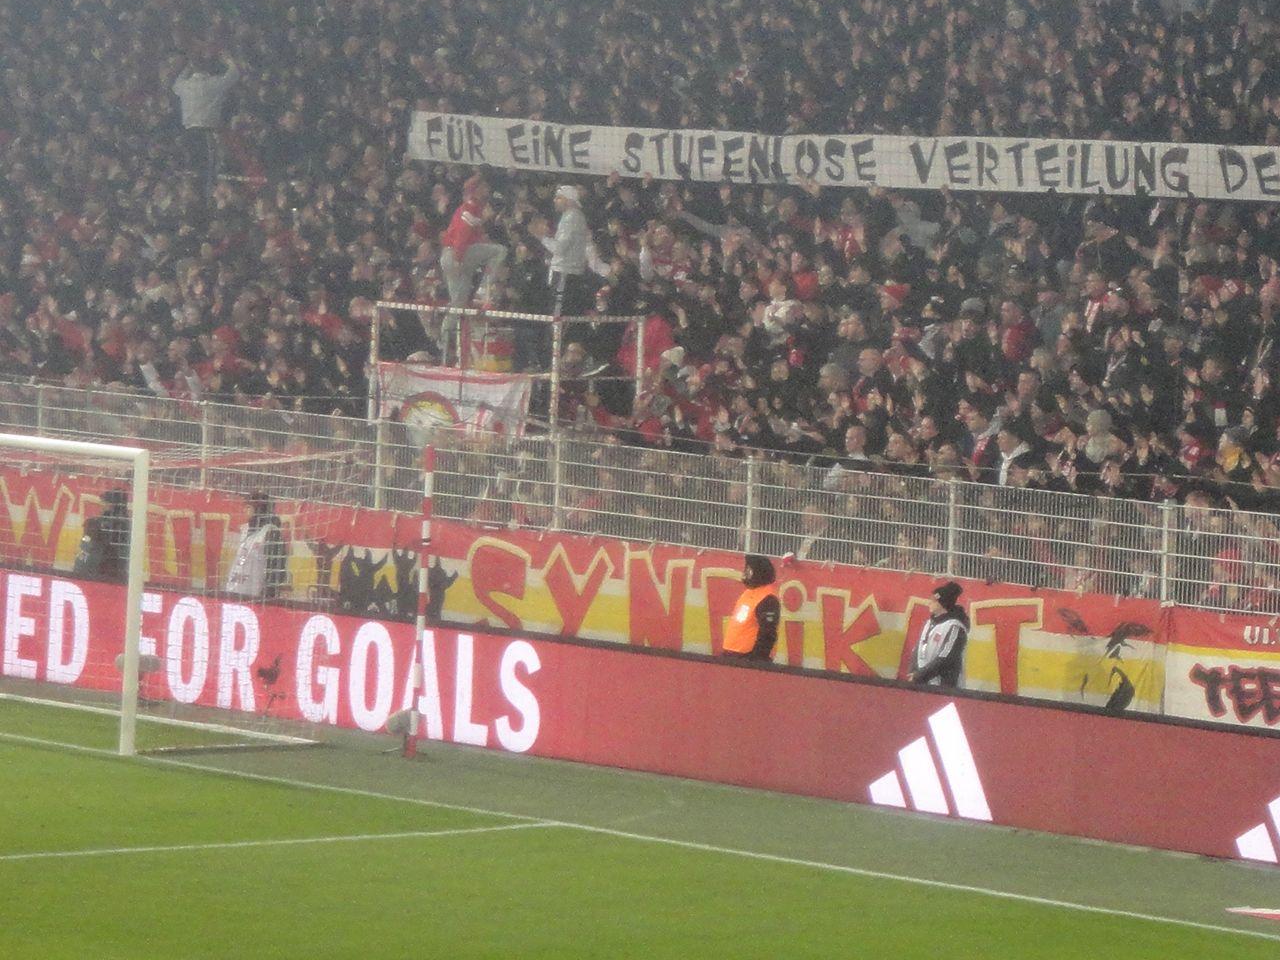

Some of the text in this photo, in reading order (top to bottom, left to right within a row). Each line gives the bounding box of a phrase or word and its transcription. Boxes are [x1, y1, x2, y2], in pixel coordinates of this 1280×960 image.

[425, 114, 486, 166] FÜR
[622, 131, 878, 186] STUFENLOSE
[2, 574, 90, 685] ED
[295, 613, 542, 753] GOALS
